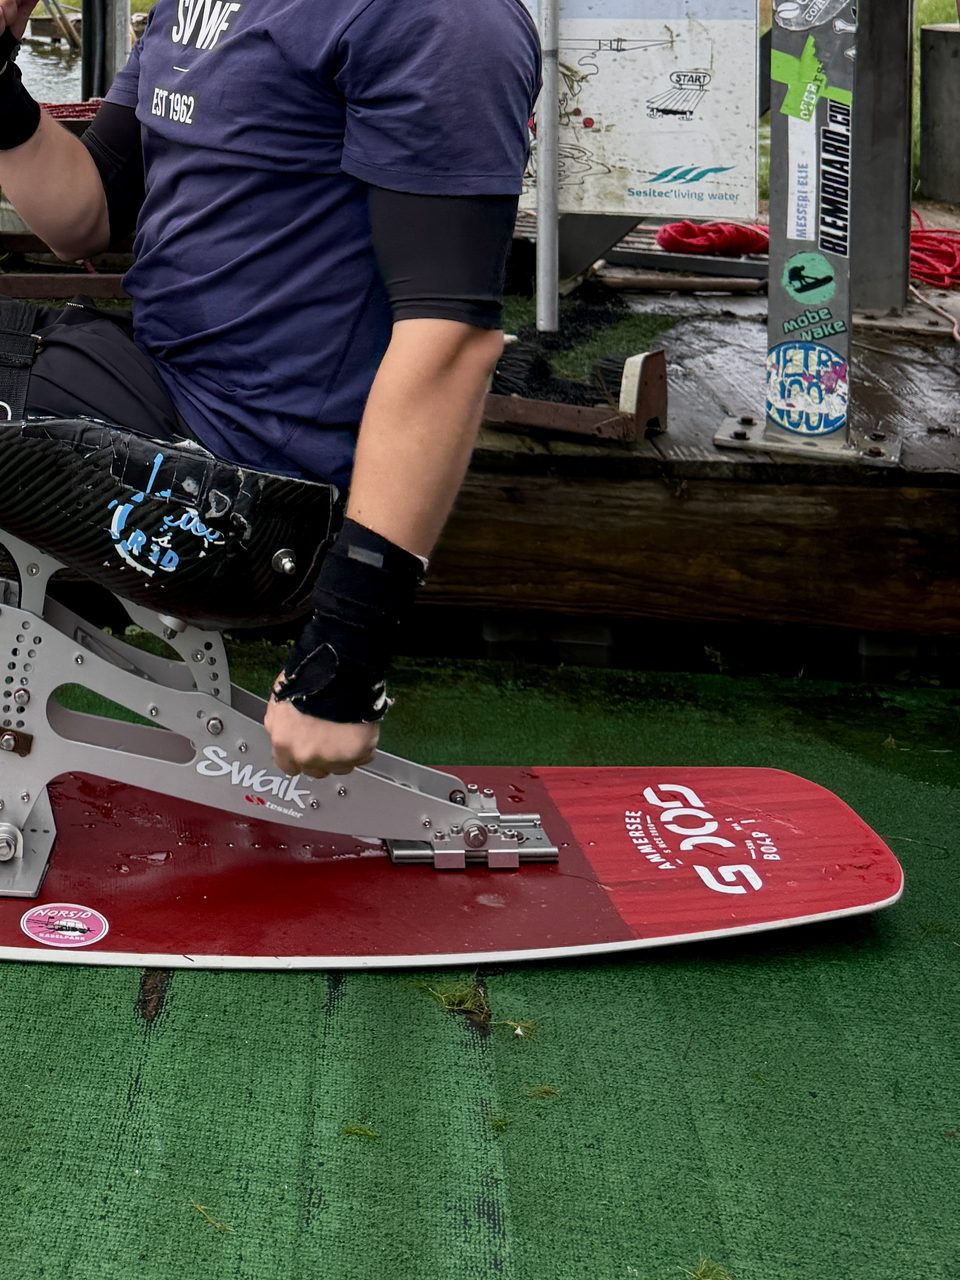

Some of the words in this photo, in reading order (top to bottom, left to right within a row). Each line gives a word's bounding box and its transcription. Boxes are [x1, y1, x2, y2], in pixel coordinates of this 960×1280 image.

[675, 73, 707, 84] START
[151, 87, 168, 117] EST
[169, 92, 195, 125] 1962
[797, 162, 809, 186] ELIE
[673, 188, 705, 202] living
[707, 190, 740, 201] water
[796, 189, 808, 239] MESSERI
[196, 745, 311, 809] Swaik
[624, 810, 677, 870] AMMERSEE
